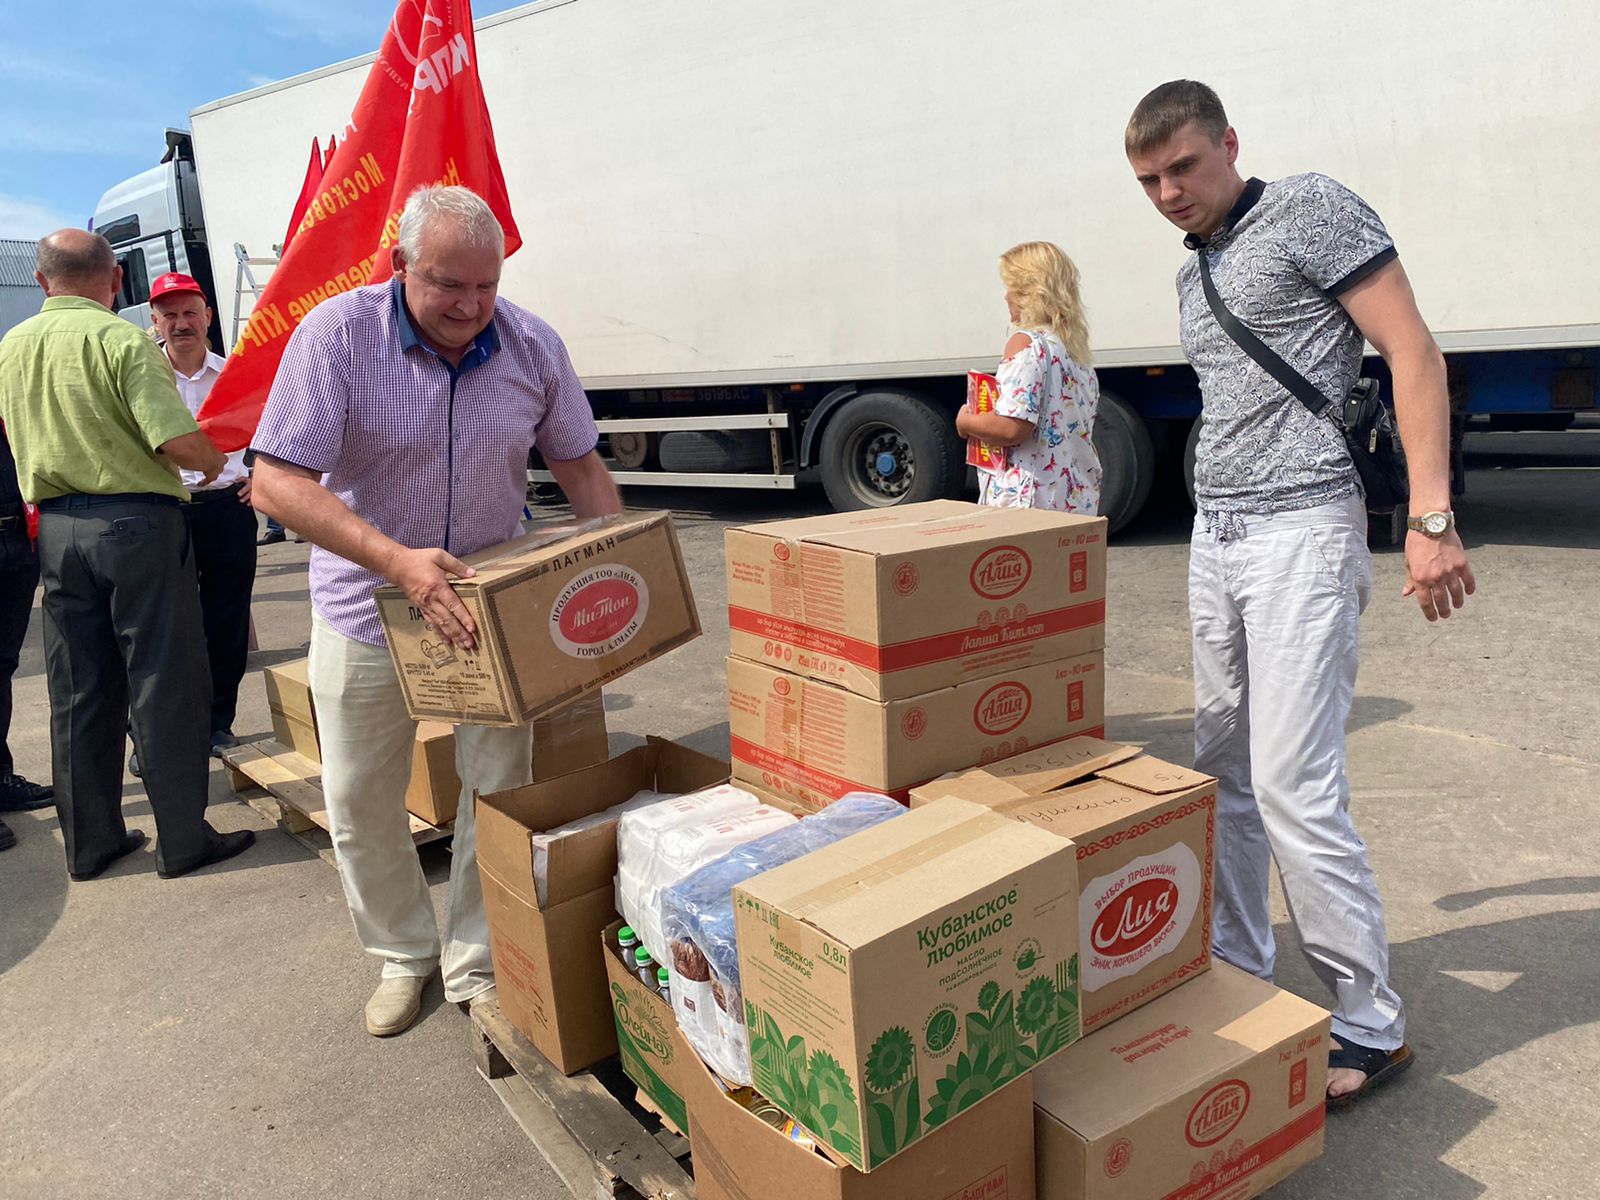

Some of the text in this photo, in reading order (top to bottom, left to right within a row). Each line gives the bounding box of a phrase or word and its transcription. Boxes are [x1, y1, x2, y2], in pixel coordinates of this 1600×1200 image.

[552, 537, 616, 572] ЛАГМАН
[979, 562, 1021, 586] Алия
[552, 571, 595, 622] ПРОДУКЦИЯ
[576, 647, 605, 657] ГОРОД
[607, 621, 638, 652] АЛМАТЫ
[960, 634, 998, 652] Лапша
[983, 698, 1022, 723] Алия
[1094, 878, 1126, 910] ВЫБОР
[1127, 864, 1177, 883] ПРОДУКЦИИ
[916, 889, 1018, 950] Кубанское
[769, 934, 814, 970] Кубанское
[927, 912, 1013, 968] любимое
[957, 947, 985, 966] МАСЛО
[1090, 920, 1177, 970] ЗНАК ХОРОШЕГО ВКУСА
[773, 950, 812, 979] любимое
[939, 948, 1003, 987] ПОДСОЛНЕЧНОЕ
[620, 1003, 666, 1055] Олейна
[1195, 1096, 1239, 1135] Алия
